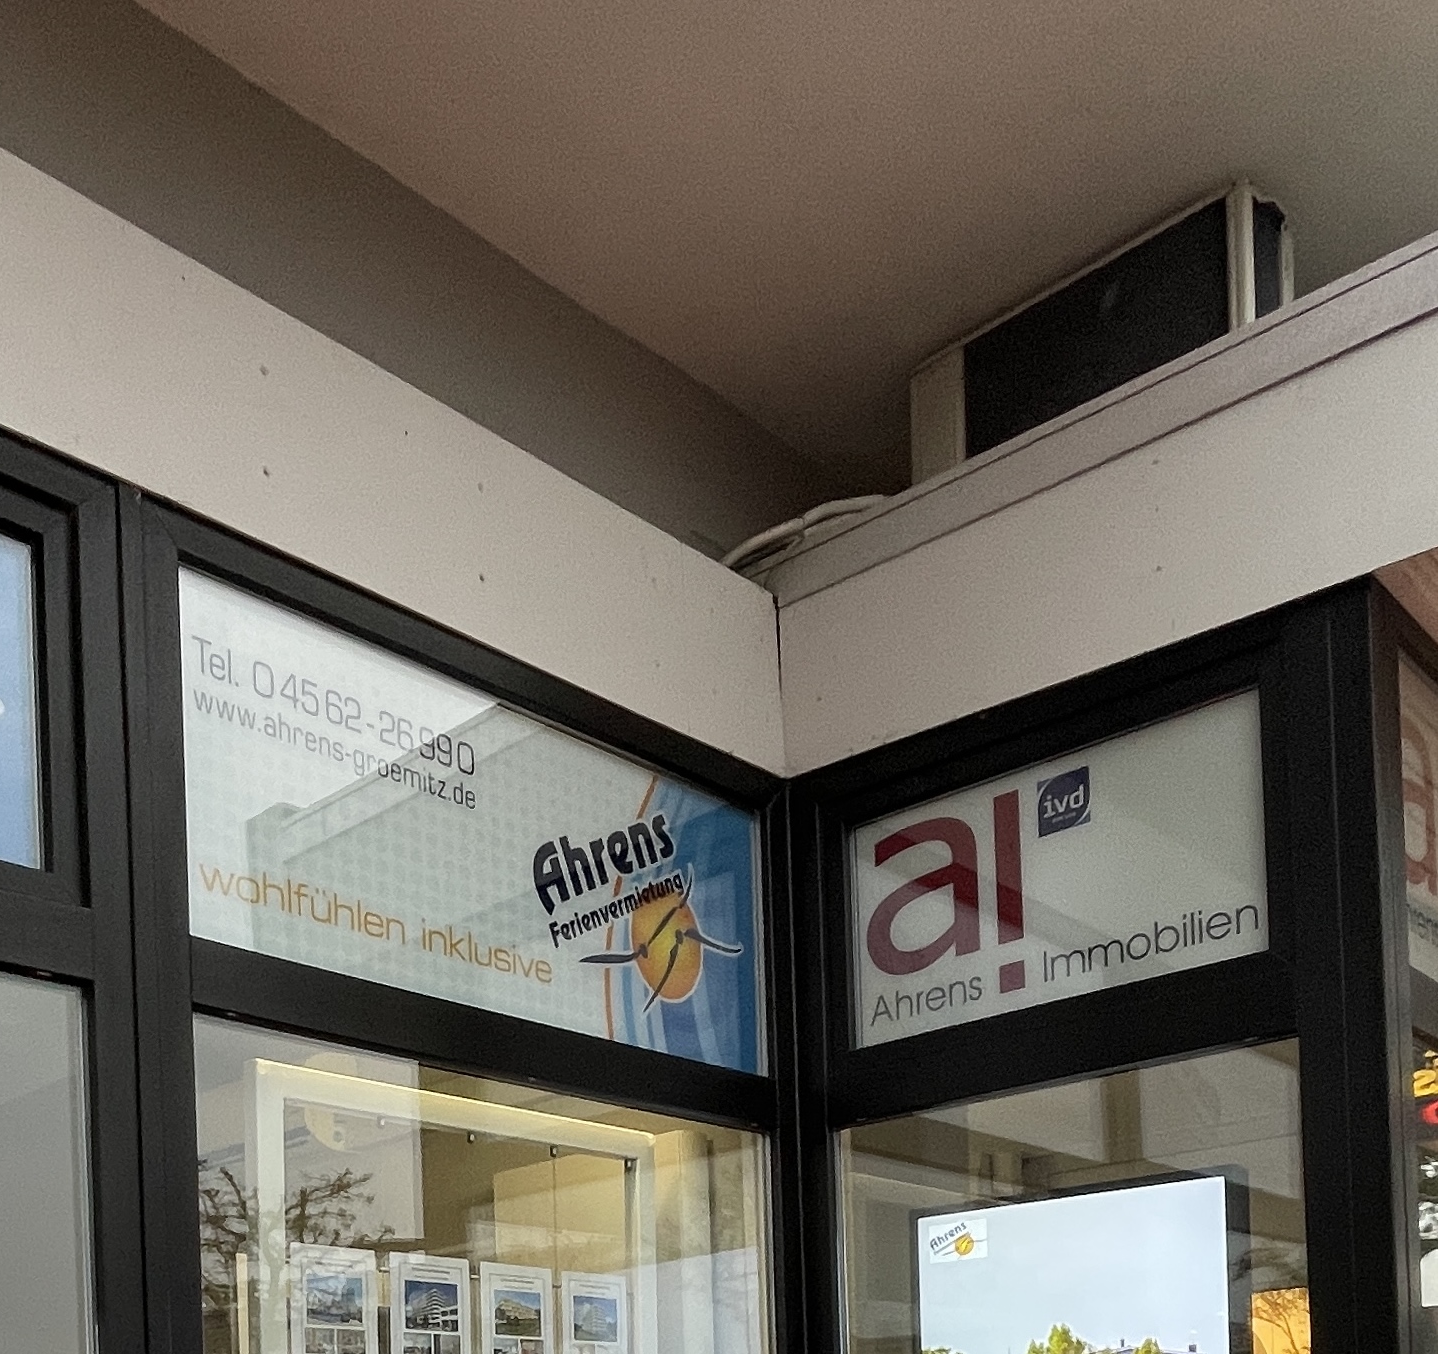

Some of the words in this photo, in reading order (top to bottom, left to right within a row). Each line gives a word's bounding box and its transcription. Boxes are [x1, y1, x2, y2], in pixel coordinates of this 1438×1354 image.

[192, 635, 240, 688] Tel.
[193, 687, 476, 809] www.ahrens-groemitz.de
[1043, 783, 1084, 819] ivd
[532, 814, 676, 915] Ahrens
[199, 862, 407, 946] wohlfühlen
[422, 919, 552, 984] inklusive
[549, 872, 685, 949] Ferienvermietung
[871, 975, 982, 1027] Ahrens
[1043, 904, 1259, 982] Immobilien
[929, 1222, 967, 1251] Ahrens
